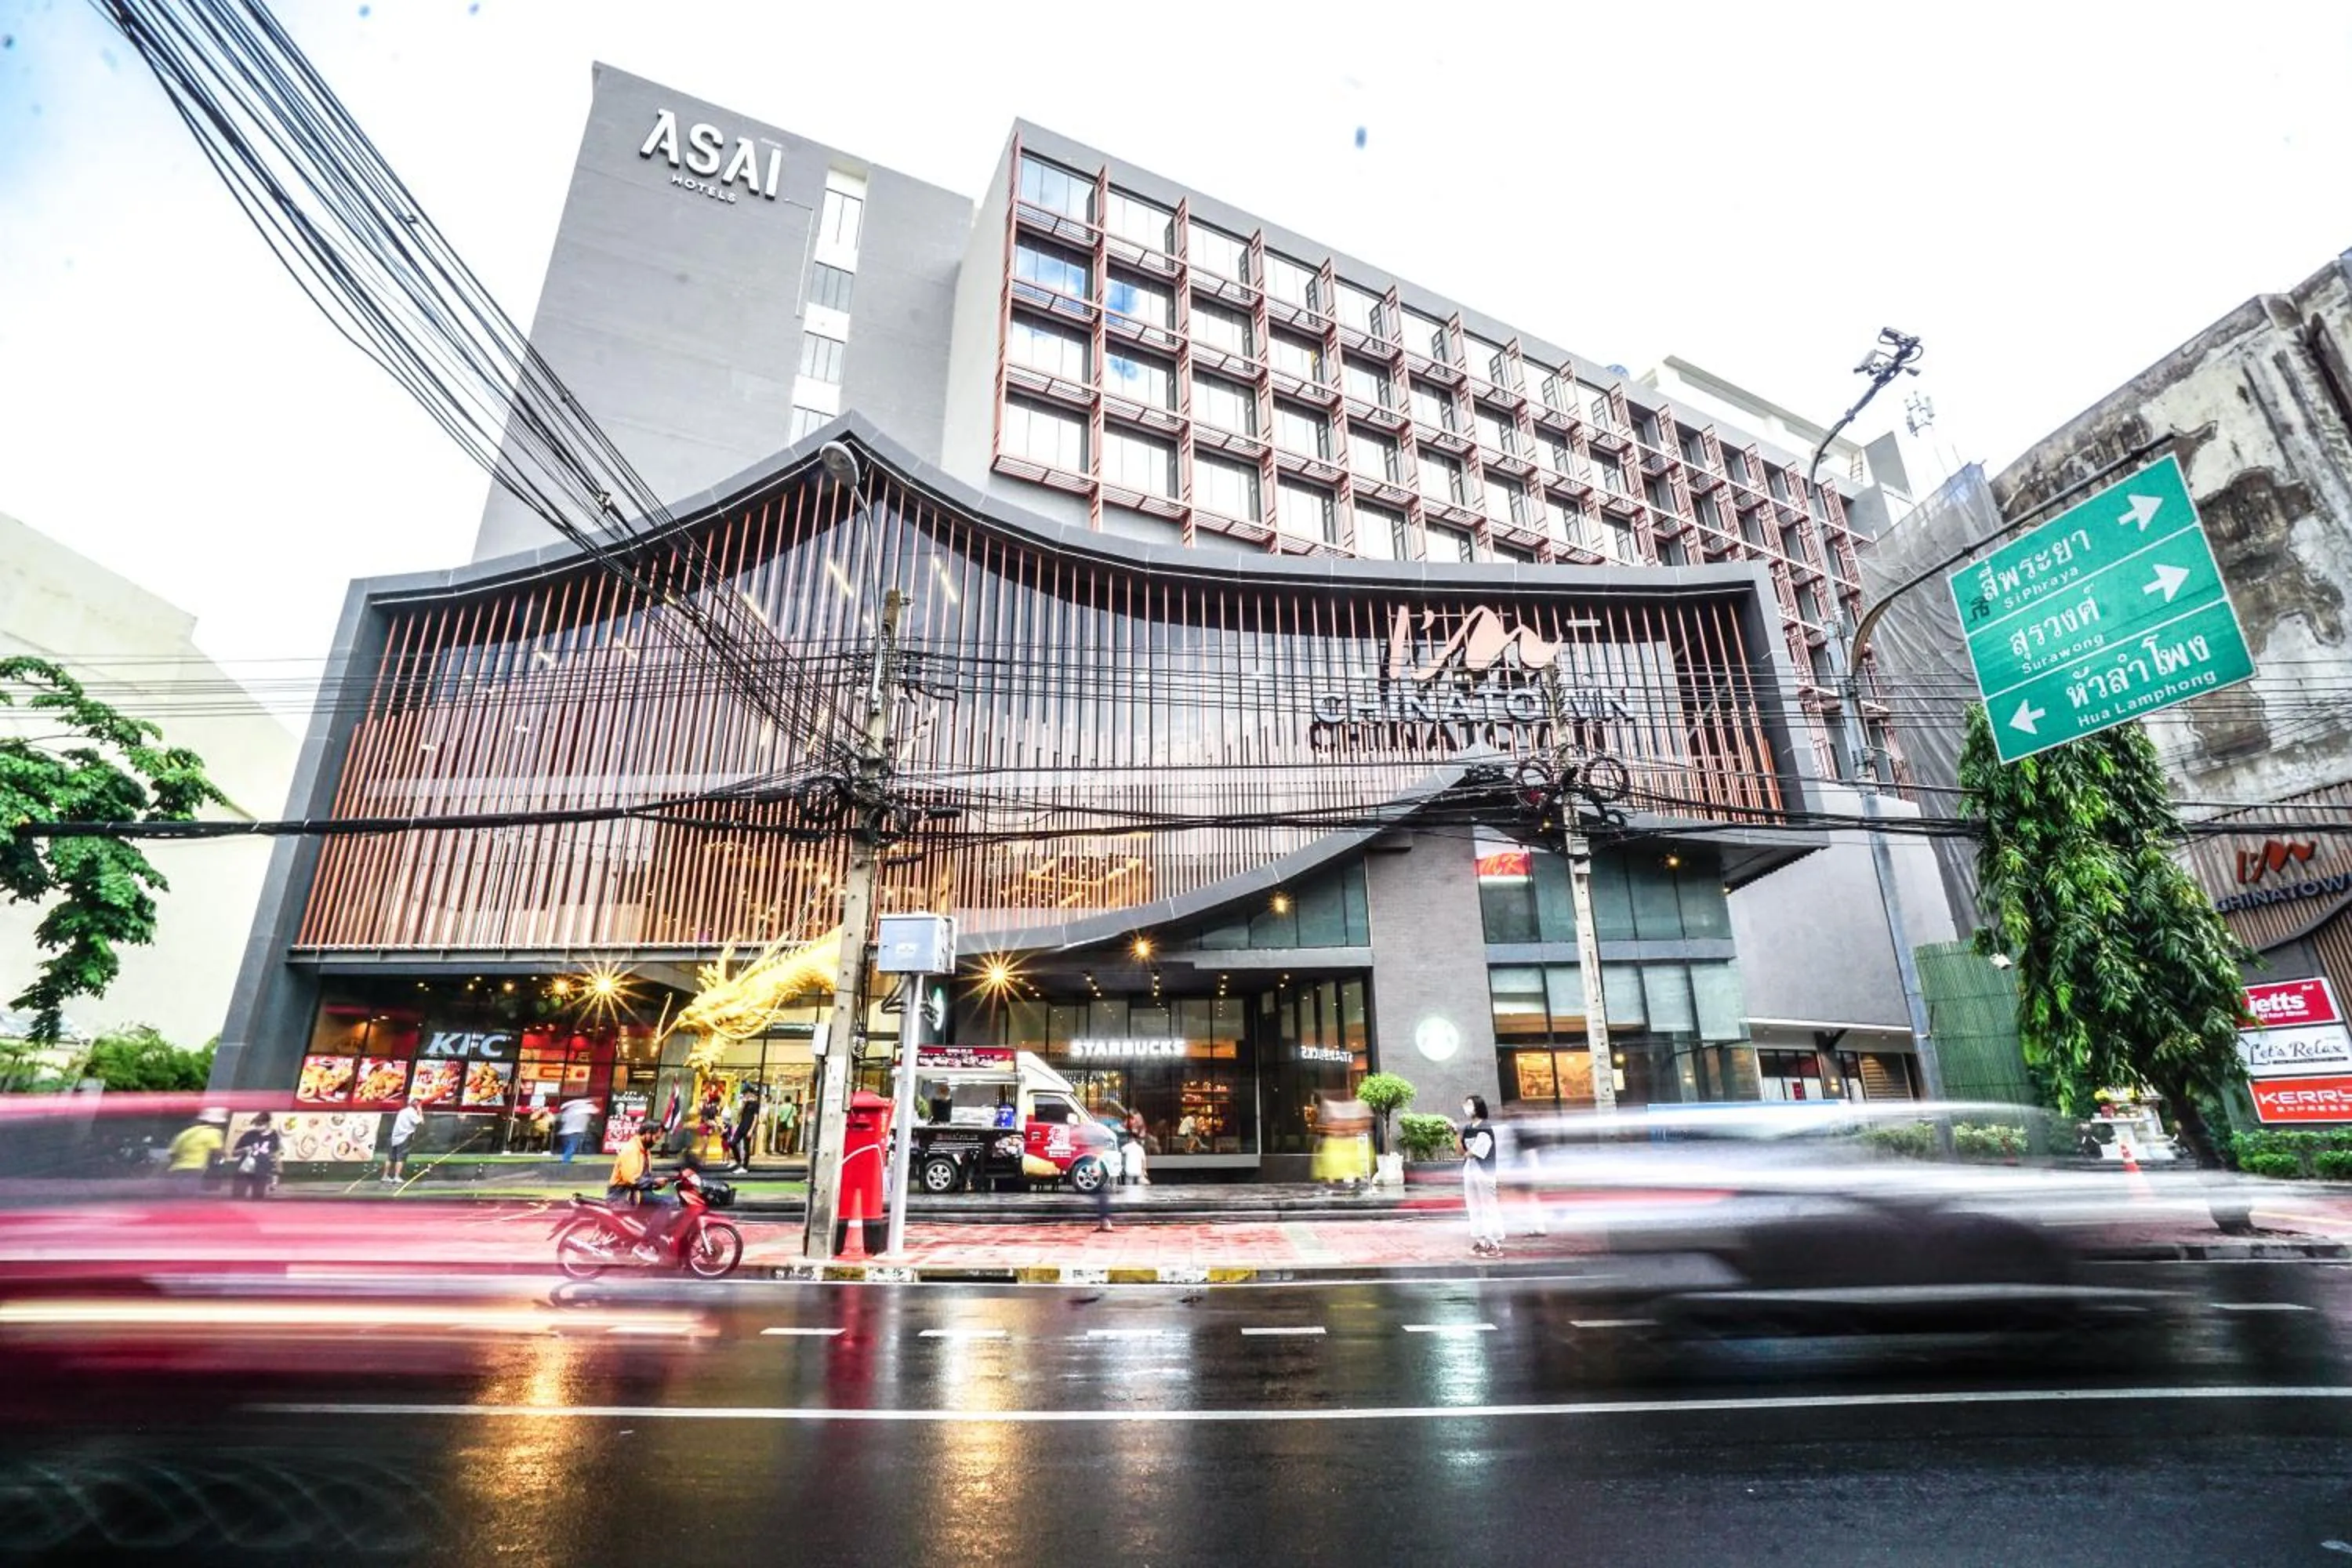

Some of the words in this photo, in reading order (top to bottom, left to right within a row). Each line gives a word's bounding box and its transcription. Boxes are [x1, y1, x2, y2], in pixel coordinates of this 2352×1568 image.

[640, 108, 782, 200] ASAI
[671, 173, 737, 204] HOTELS
[1978, 529, 2092, 601] สี่พระยา
[2022, 633, 2105, 674] Surawong
[2066, 634, 2211, 710] หัวลำโพง
[2078, 710, 2111, 728] Hua
[2115, 670, 2217, 714] Lamphong
[424, 1031, 508, 1058] KFC
[1070, 1039, 1186, 1056] STARBUCKS
[2249, 1044, 2286, 1065] Let's
[2288, 1038, 2343, 1058] Relax
